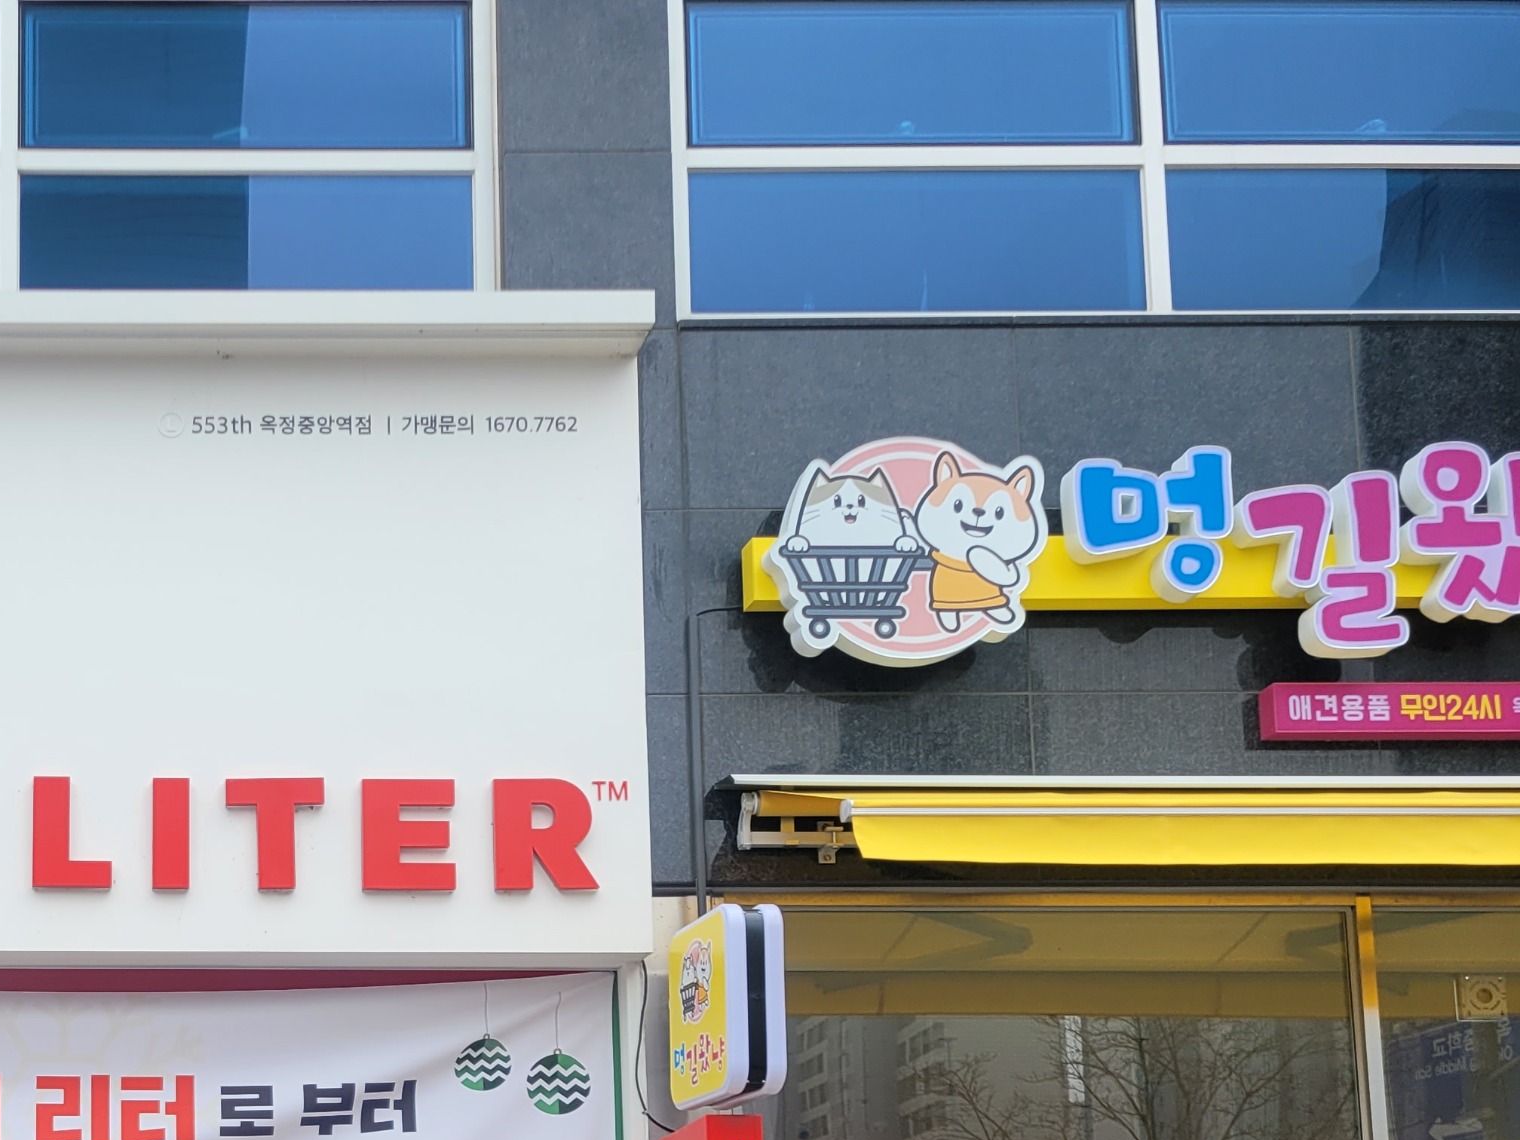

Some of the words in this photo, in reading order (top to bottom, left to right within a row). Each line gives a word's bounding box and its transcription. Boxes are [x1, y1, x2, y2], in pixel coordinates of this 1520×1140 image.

[191, 415, 252, 436] 553th
[260, 414, 373, 436] 옥정중앙역점
[401, 414, 475, 436] 가맹문의
[485, 416, 578, 433] 1670.7762
[1288, 694, 1391, 721] 애견용품
[1400, 694, 1502, 721] 무인24시
[32, 776, 601, 894] LITER
[219, 1085, 275, 1137] 로
[300, 1079, 417, 1135] 부터
